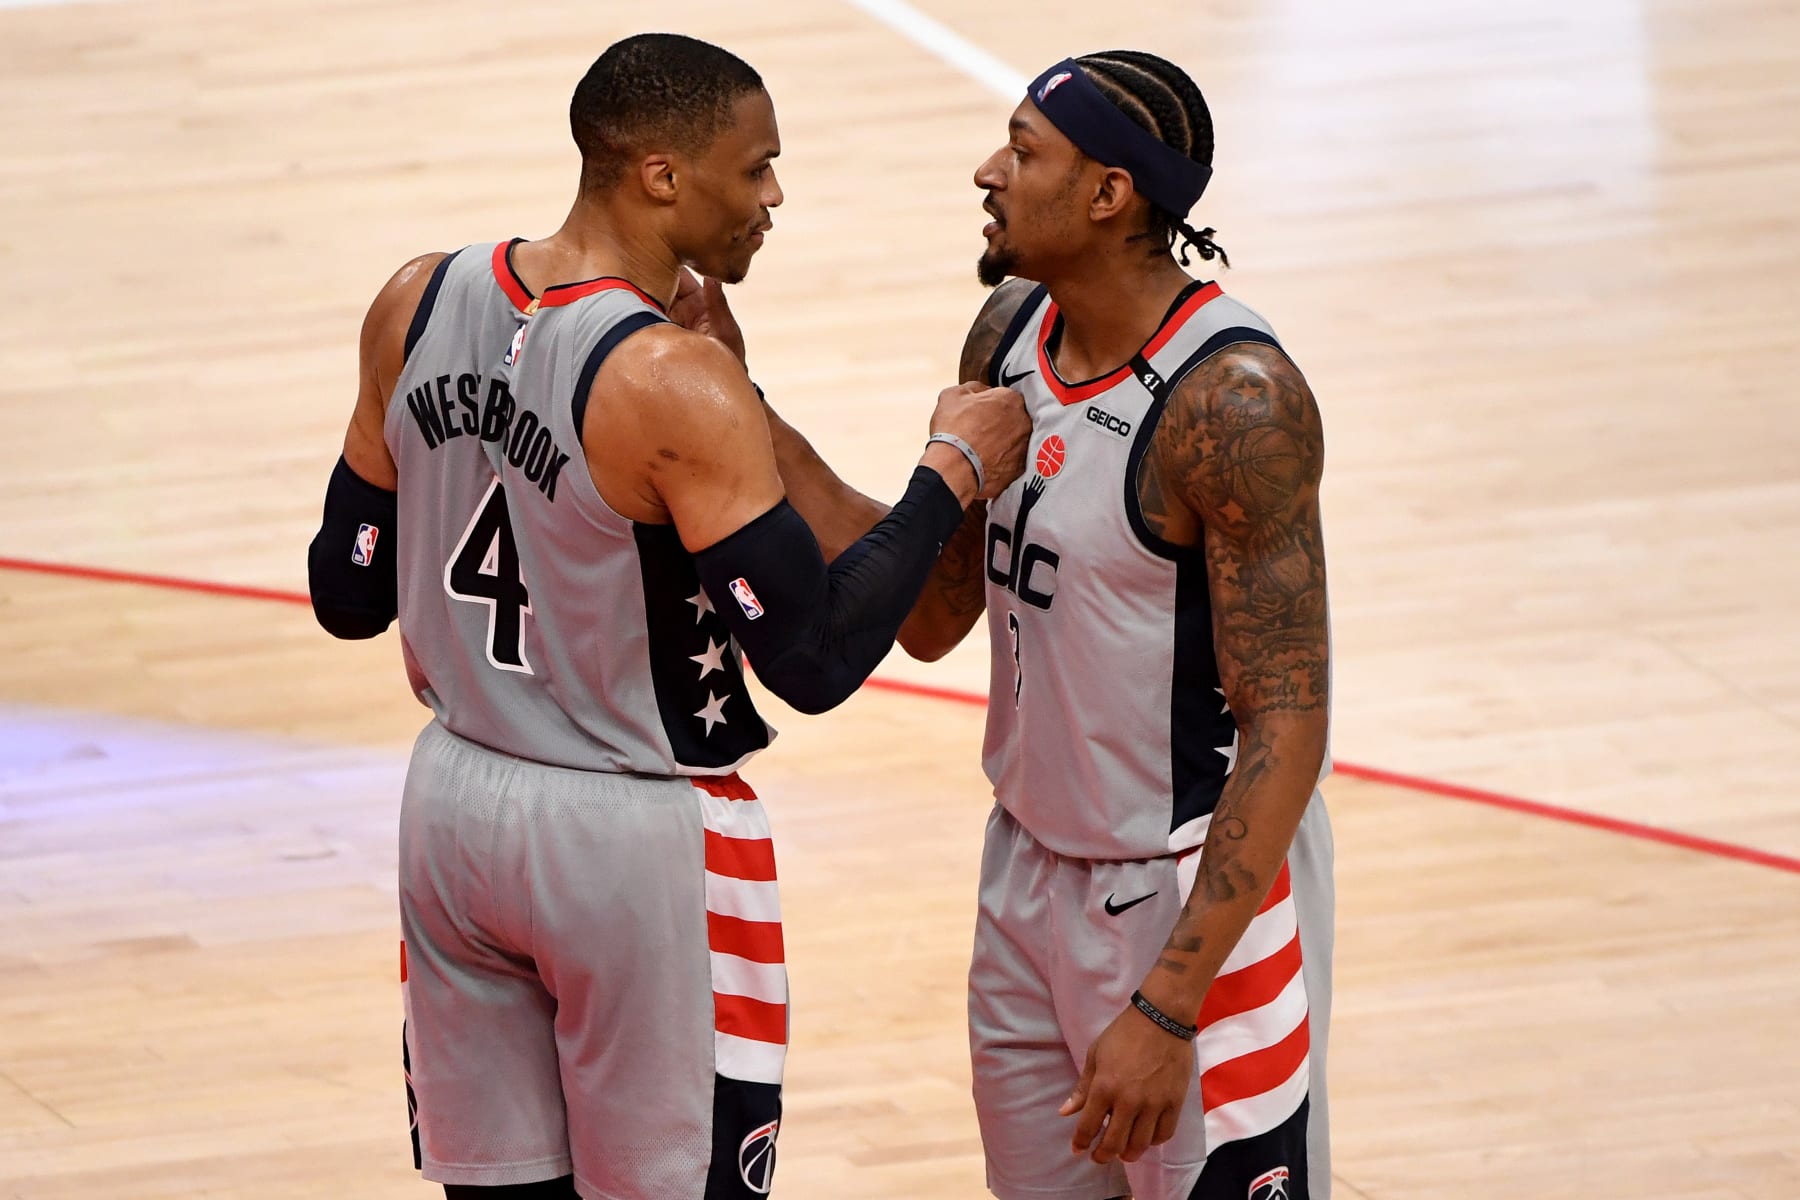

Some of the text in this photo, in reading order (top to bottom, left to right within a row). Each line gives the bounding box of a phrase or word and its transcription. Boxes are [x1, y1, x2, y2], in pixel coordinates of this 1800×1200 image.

[1086, 406, 1131, 437] GEICO
[1143, 373, 1160, 391] 41
[406, 373, 570, 503] WESBROOK
[443, 475, 535, 675] 4
